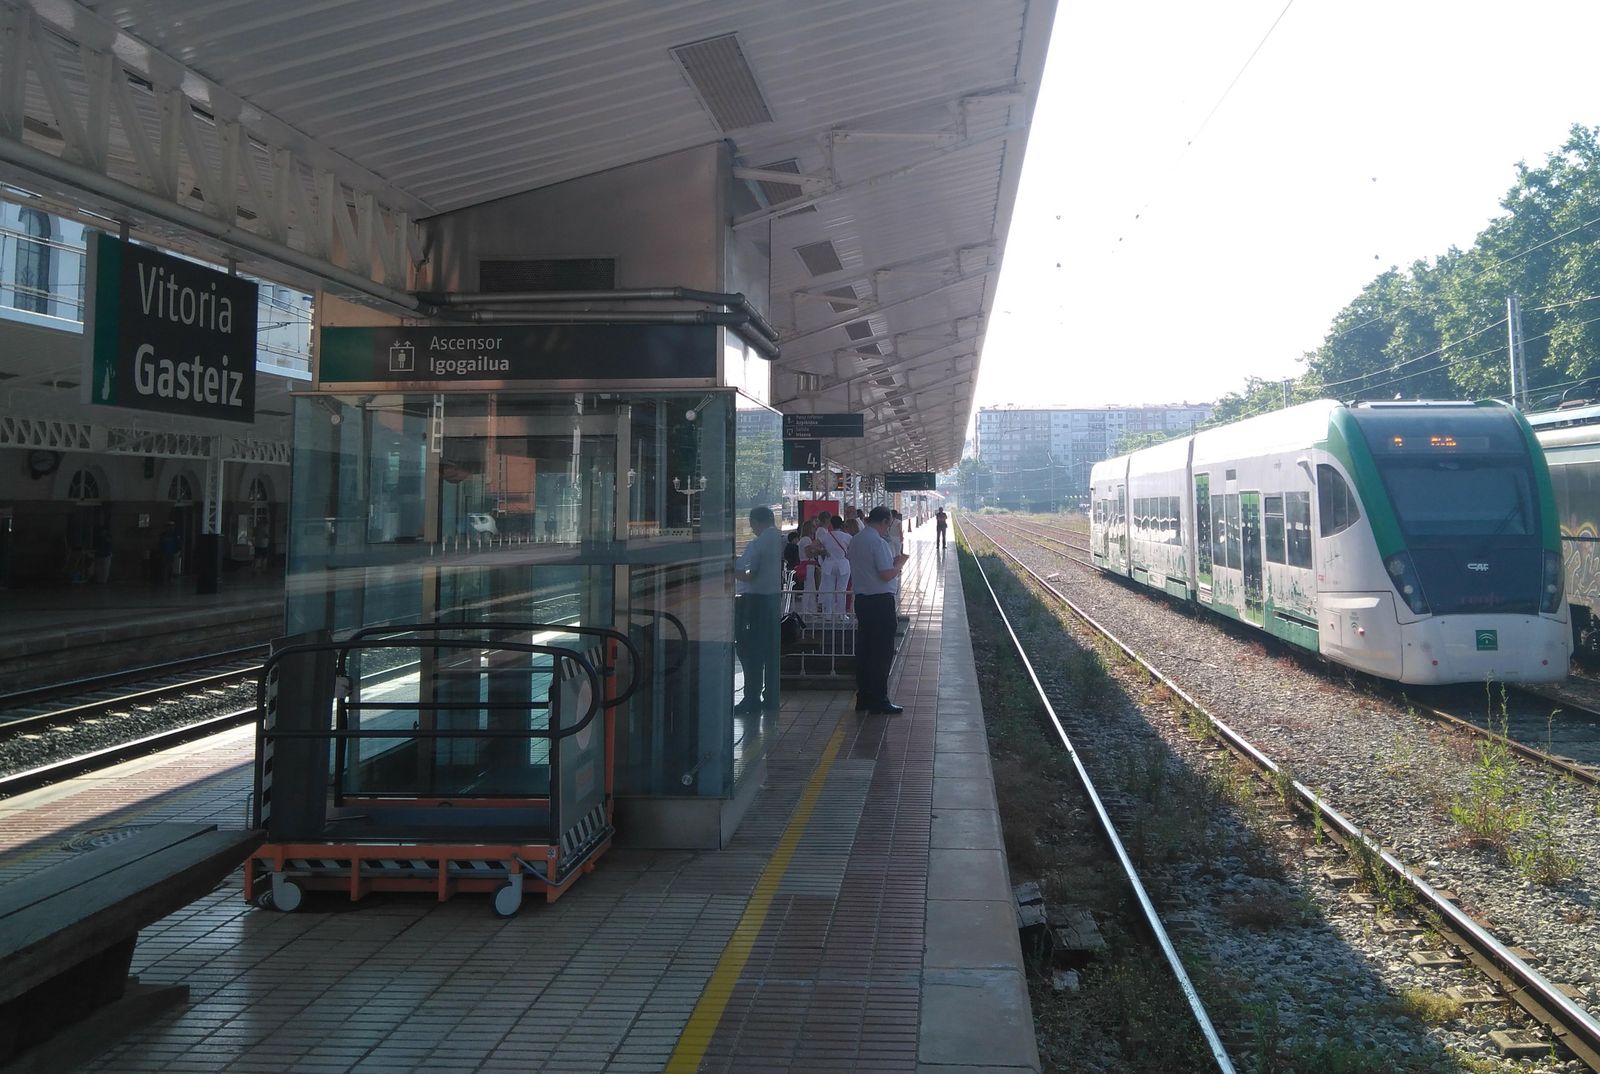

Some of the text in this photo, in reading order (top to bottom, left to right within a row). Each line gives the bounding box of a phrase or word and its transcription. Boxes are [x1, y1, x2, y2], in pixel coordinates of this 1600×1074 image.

[138, 262, 232, 334] Vitoria
[430, 336, 503, 350] Ascensor
[430, 355, 509, 375] Igogailua
[134, 344, 244, 408] Gasteiz
[807, 452, 818, 468] 4
